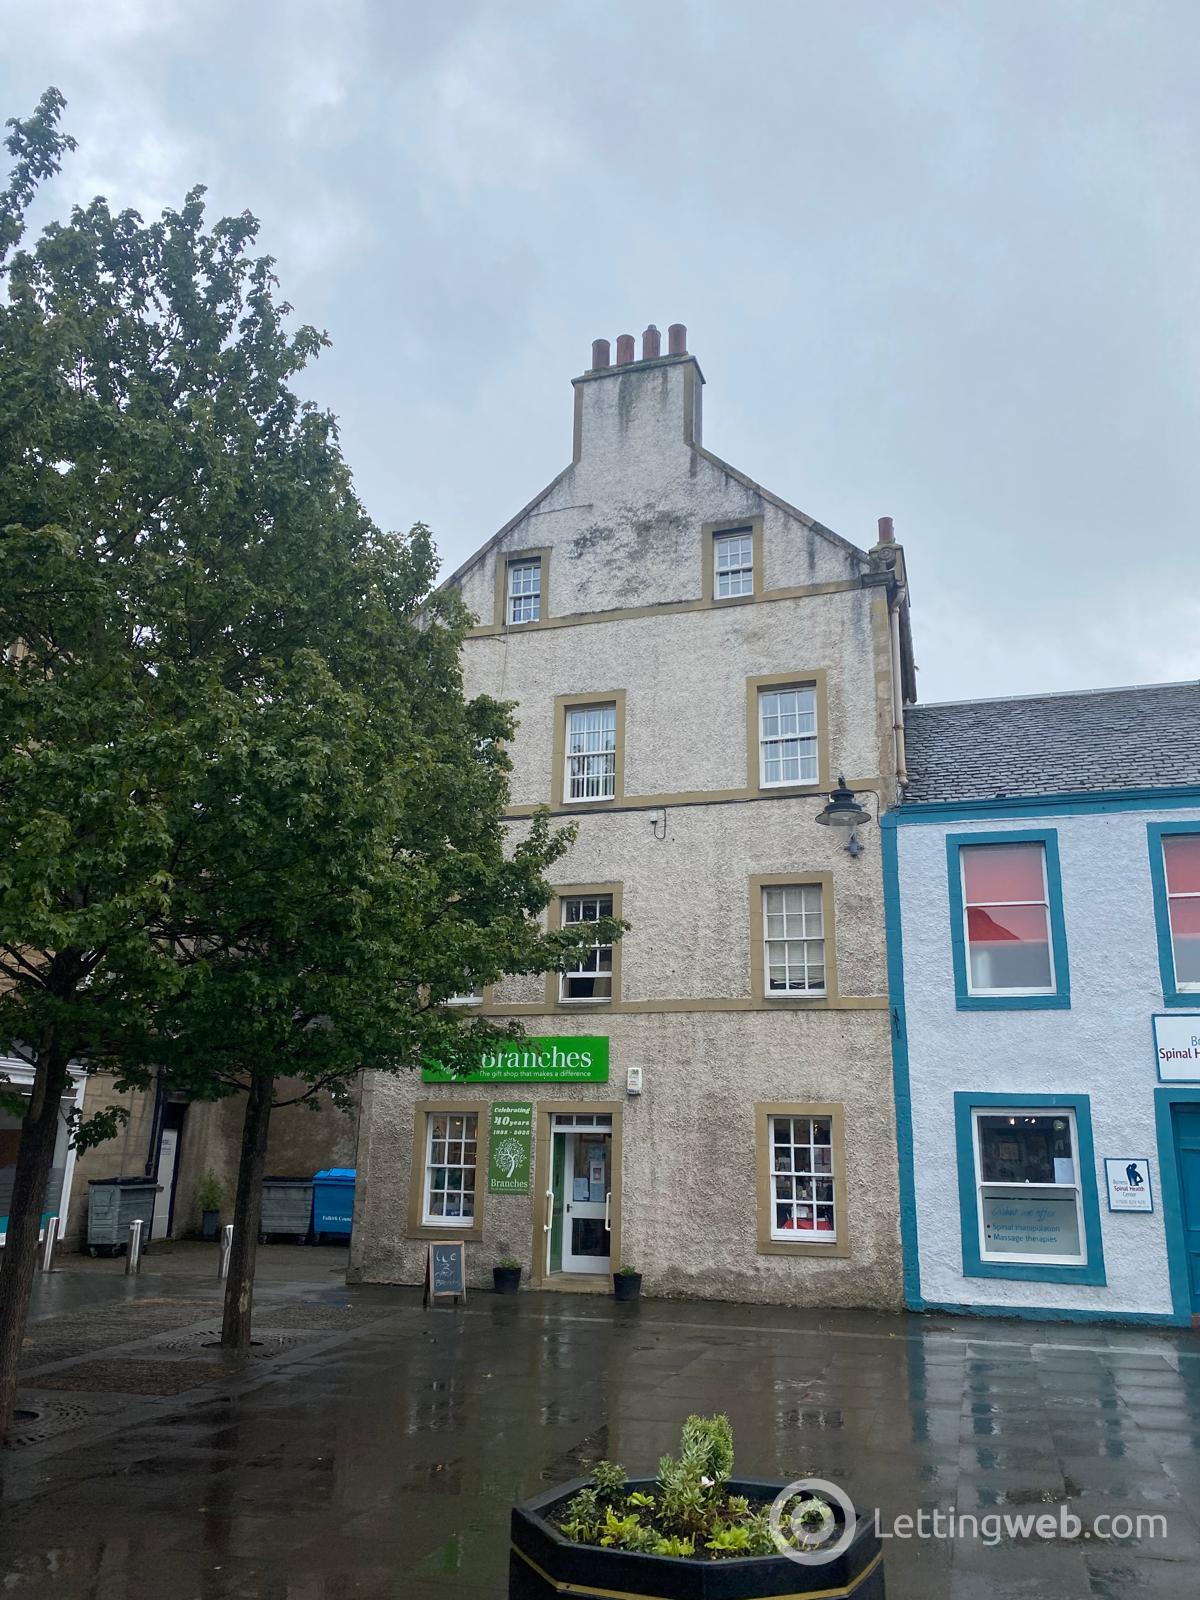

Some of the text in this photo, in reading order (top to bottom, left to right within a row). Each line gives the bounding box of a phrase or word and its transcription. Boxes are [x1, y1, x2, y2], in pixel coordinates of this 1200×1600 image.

[1159, 1048, 1192, 1062] Spinal
[492, 1070, 502, 1078] gift
[504, 1070, 519, 1078] shop
[491, 1178, 528, 1188] Branches
[994, 1234, 1023, 1242] Massage
